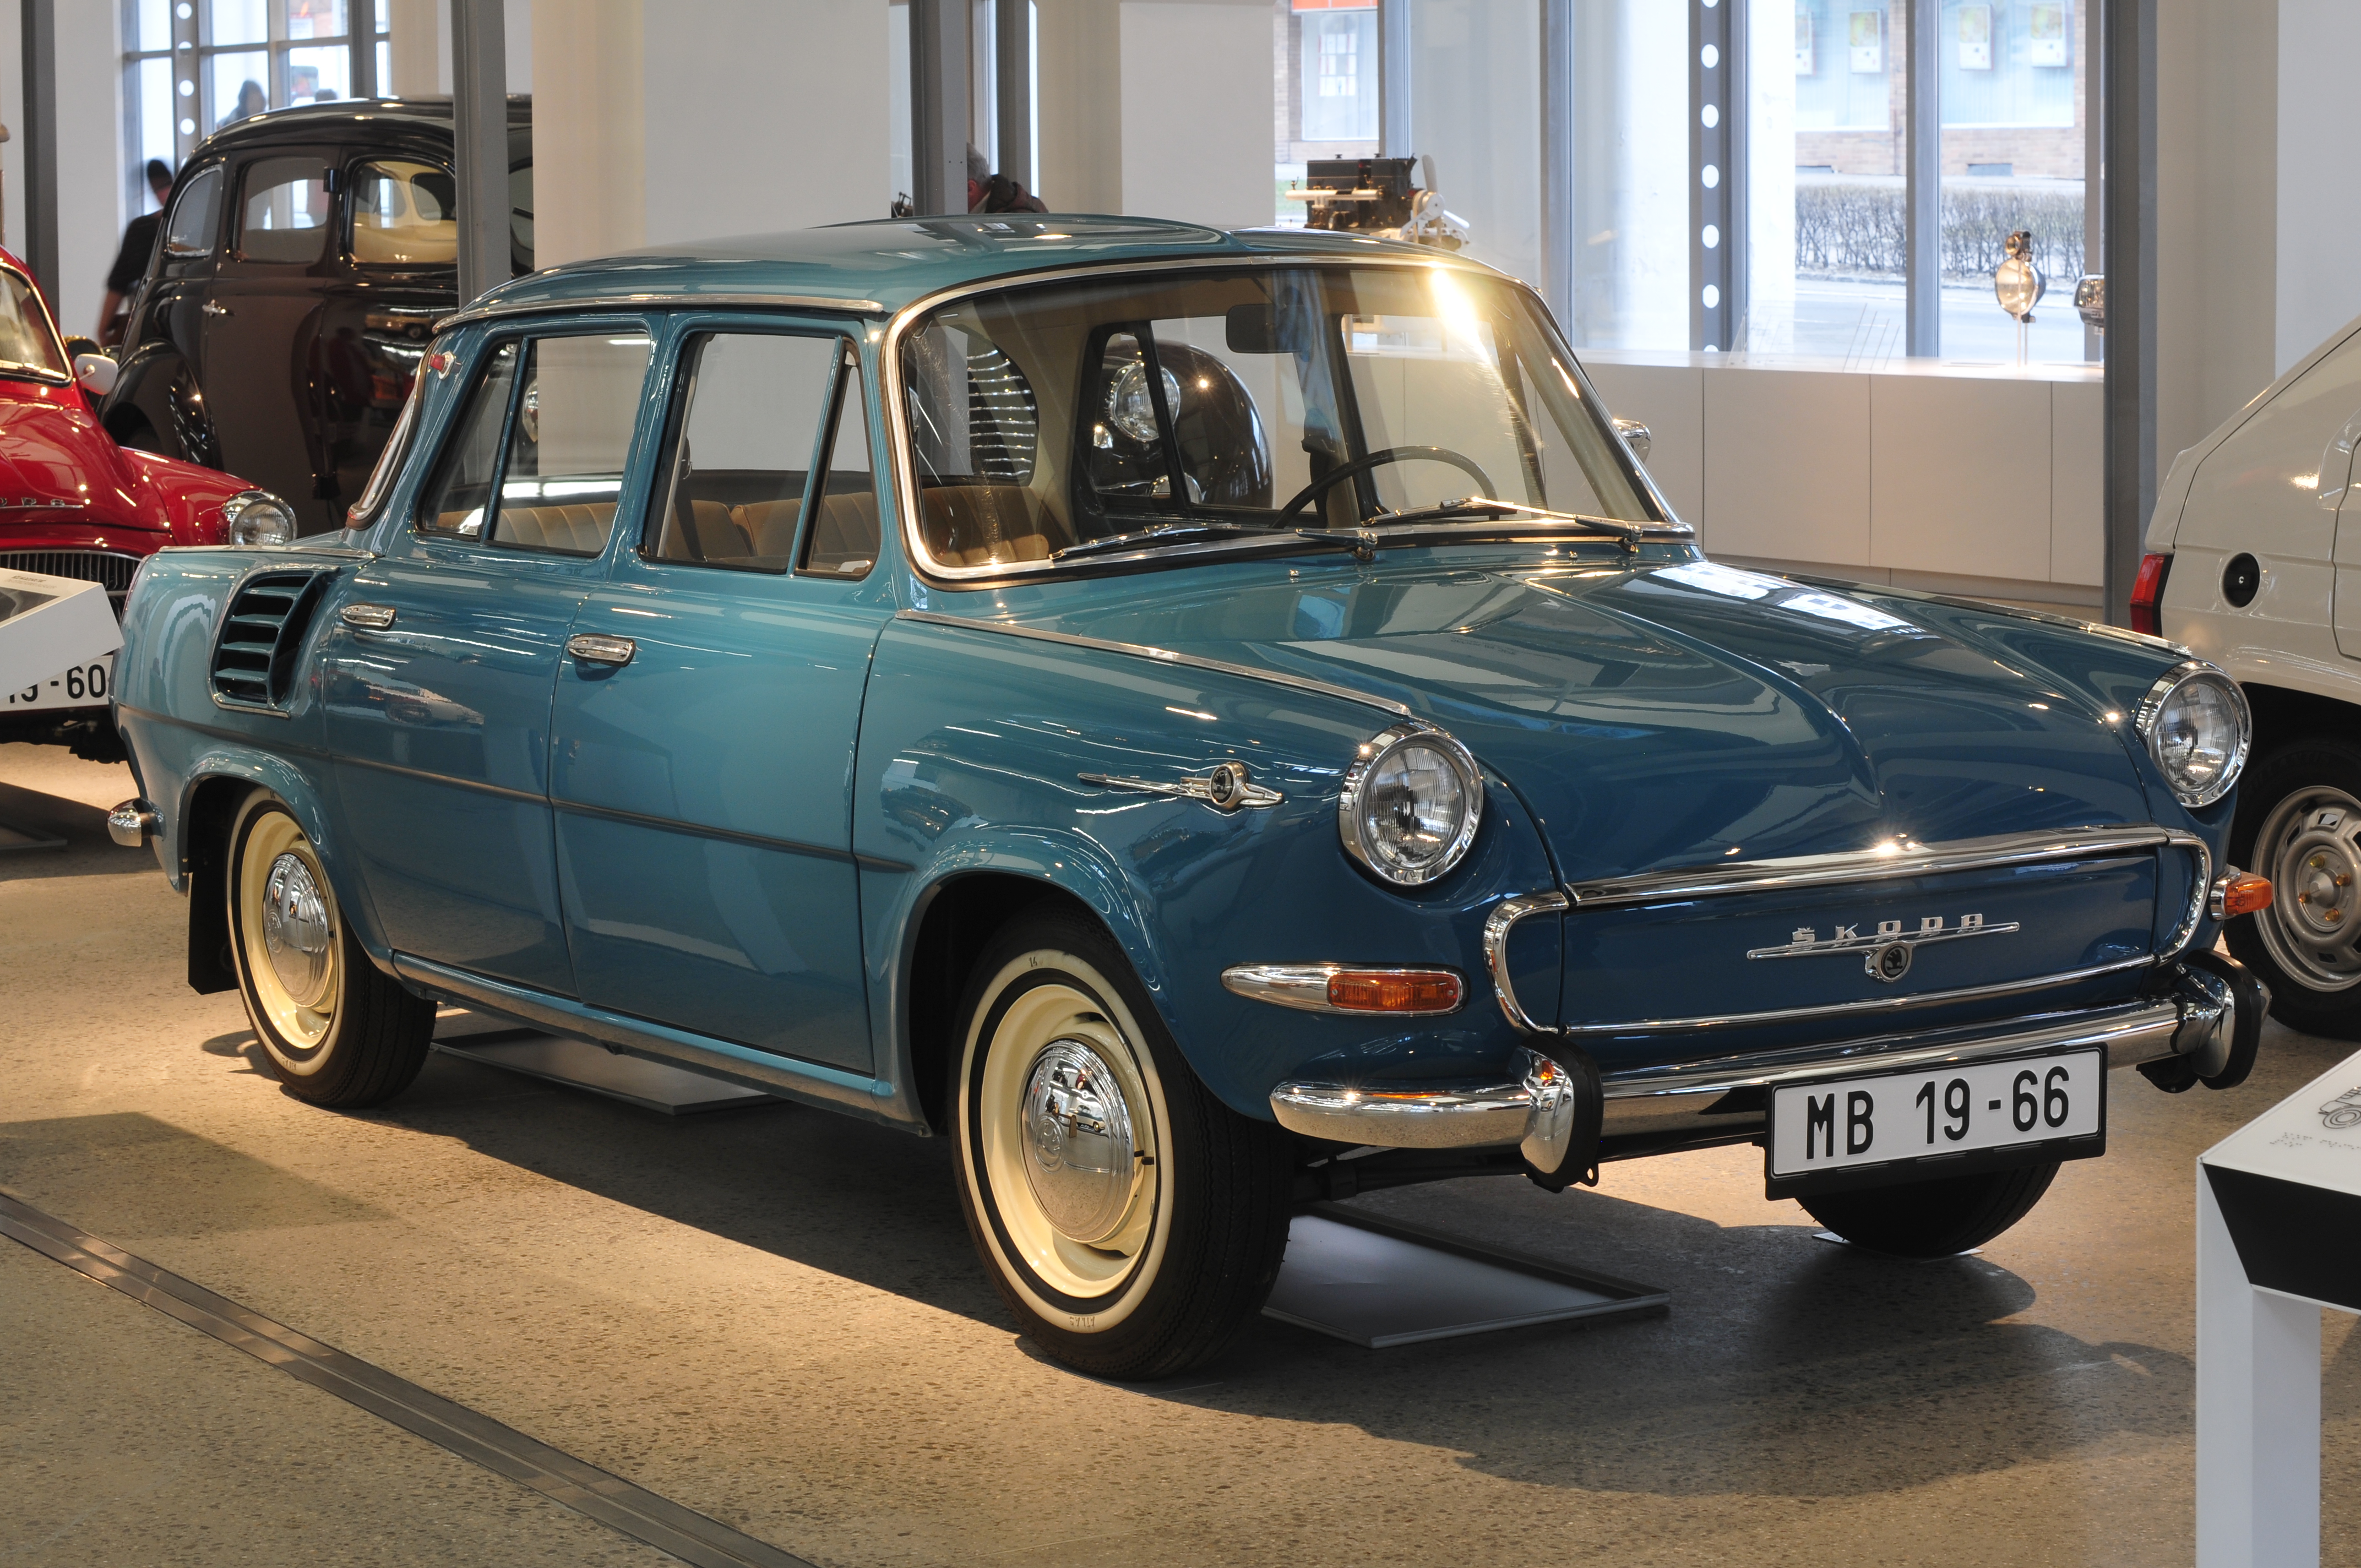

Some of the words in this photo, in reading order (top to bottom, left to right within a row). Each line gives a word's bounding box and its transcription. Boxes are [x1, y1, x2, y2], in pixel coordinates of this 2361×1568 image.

[1792, 913, 1983, 945] ŠKODA
[1807, 1090, 1874, 1159] MB
[1916, 1066, 2070, 1144] 19-66
